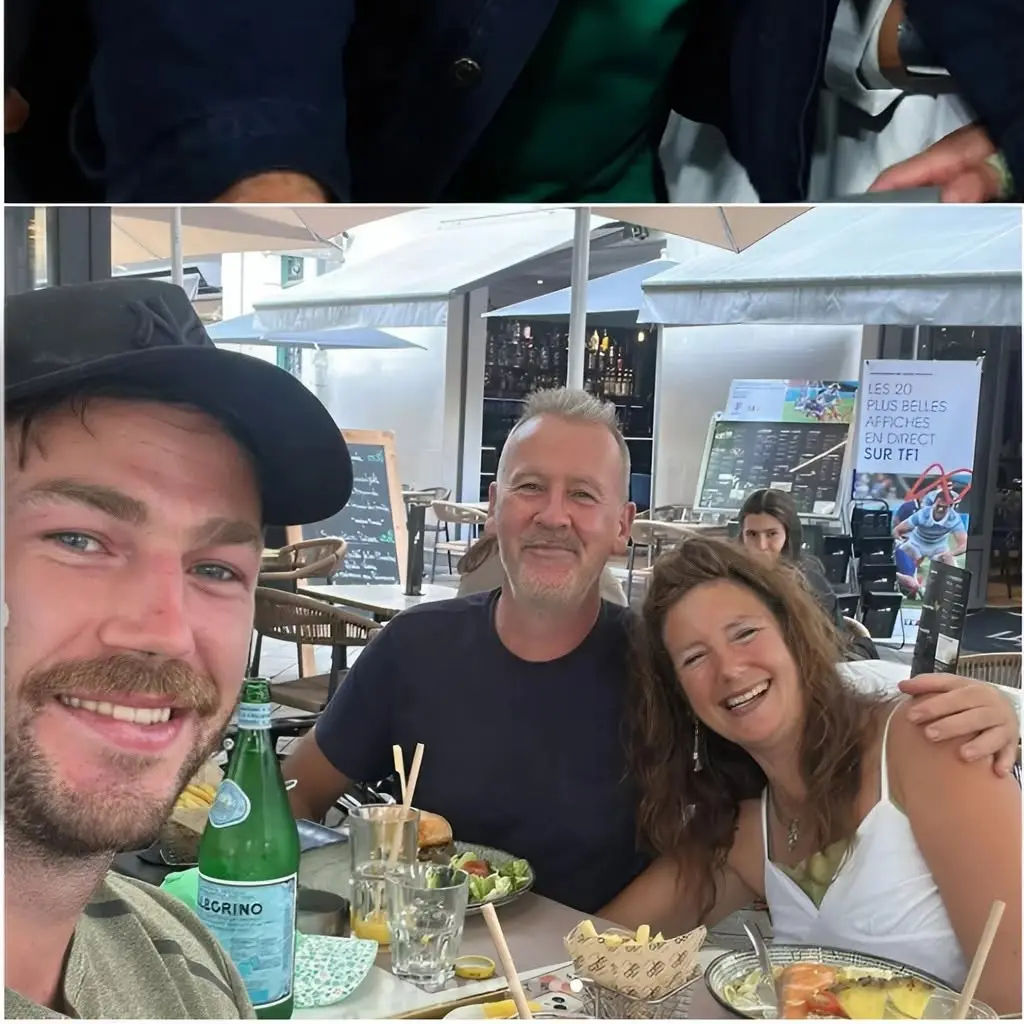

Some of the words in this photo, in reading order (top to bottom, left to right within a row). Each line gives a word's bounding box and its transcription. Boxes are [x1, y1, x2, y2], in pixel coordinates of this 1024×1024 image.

[868, 383, 890, 395] LES
[895, 383, 912, 395] 20
[867, 400, 898, 412] PLUS
[902, 400, 947, 413] BELLES
[865, 416, 930, 429] AFFICHES
[865, 432, 882, 444] EN
[887, 433, 935, 446] DIRECT
[864, 447, 892, 460] SUR
[898, 448, 919, 461] TF1
